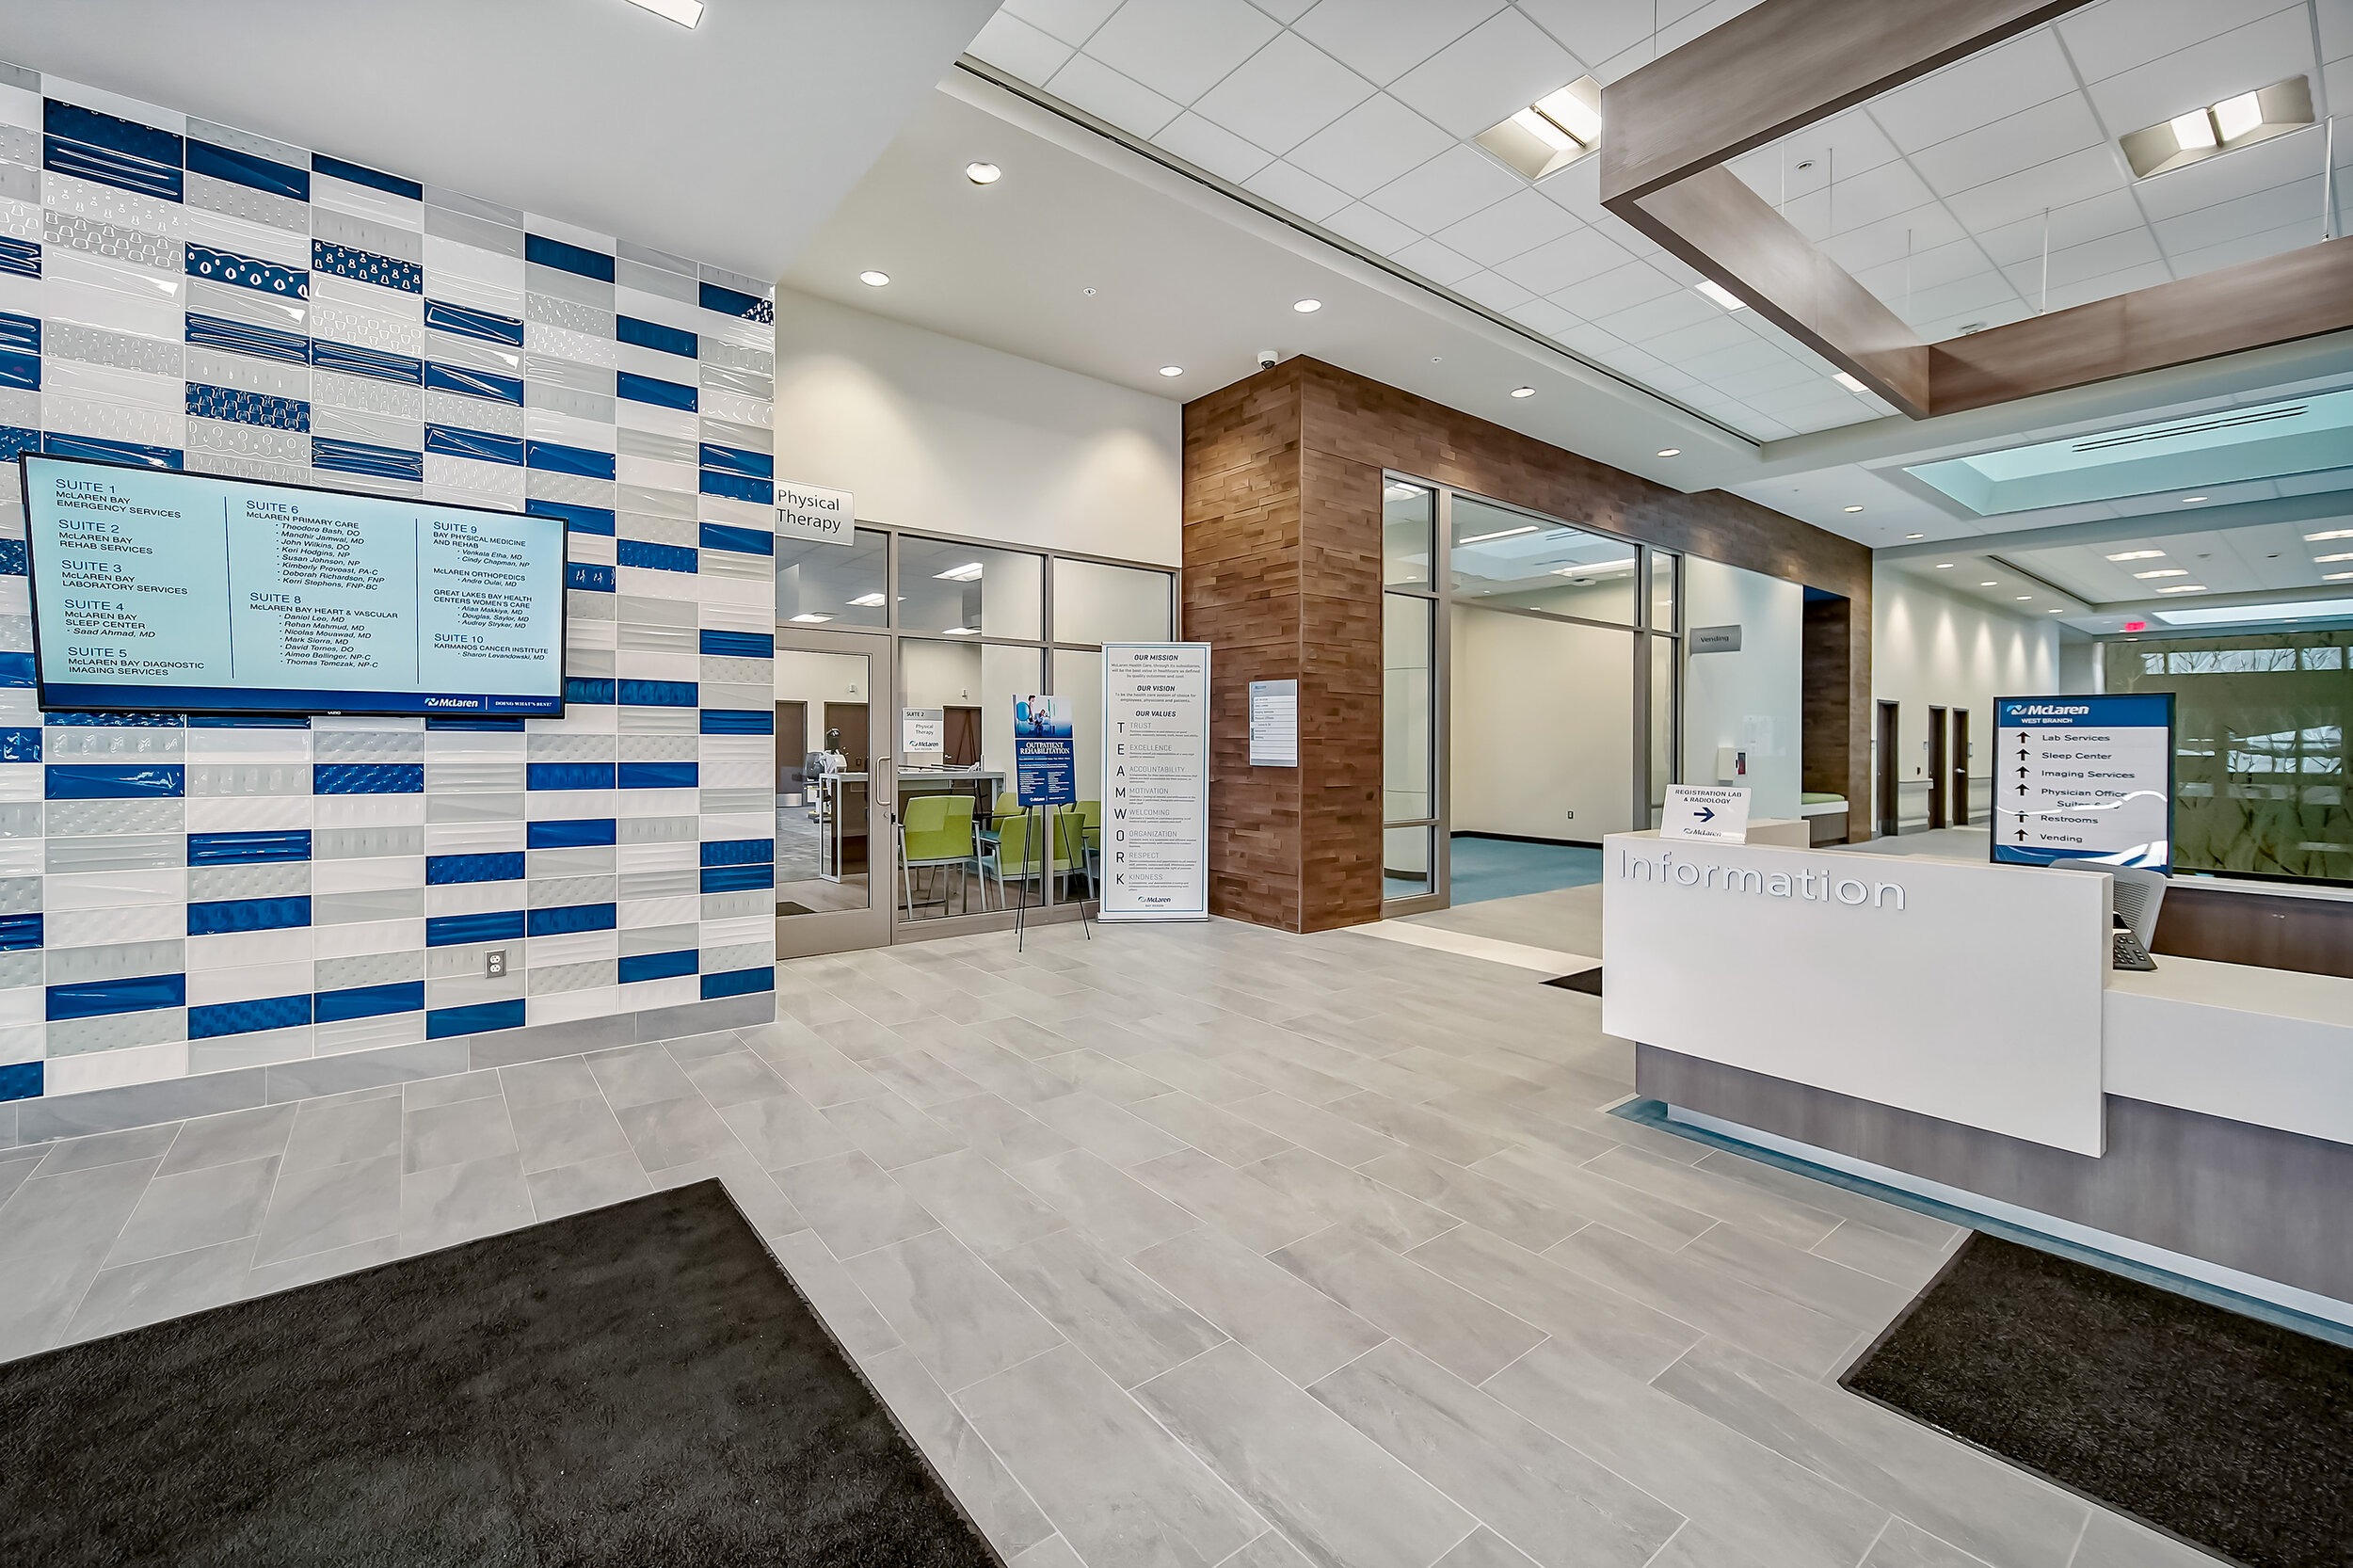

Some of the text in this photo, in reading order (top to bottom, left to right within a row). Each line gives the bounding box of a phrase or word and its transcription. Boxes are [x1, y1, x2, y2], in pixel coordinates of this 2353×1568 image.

[56, 478, 115, 494] SUITE 1
[56, 490, 131, 504] McLAREN BAY
[777, 489, 840, 511] Physical
[56, 499, 181, 519] EMERGENCY SERVICES
[246, 500, 298, 515] SUITE 6
[246, 510, 359, 529] McLAREN PRIMARY CARE
[776, 508, 841, 534] Therapy
[58, 519, 120, 534] SUITE 2
[433, 520, 477, 534] SUITE 9
[58, 531, 133, 544] McLAREN BAY
[280, 530, 314, 539] Mandhir
[315, 534, 348, 544] Jamwal,
[450, 533, 488, 543] PHYSICAL
[489, 537, 526, 547] MEDICINE
[59, 539, 152, 554] REHAB SERVICES
[303, 540, 334, 550] Wilkins,
[452, 540, 479, 549] REHAB
[61, 559, 121, 573] SUITE 3
[281, 553, 308, 562] Susan
[309, 555, 345, 566] Johnson,
[461, 555, 482, 565] Cindy
[483, 557, 518, 568] Chapman,
[61, 570, 136, 583] McLAREN BAY
[282, 568, 317, 578] Deborah
[319, 571, 365, 583] Richardson,
[433, 568, 525, 582] McLAREN ORTHOPEDICS
[62, 580, 188, 595] LABORATORY SERVICES
[433, 588, 460, 597] GREAT
[249, 591, 301, 604] SUITE 8
[433, 596, 471, 604] CENTERS
[472, 599, 508, 607] WOMEN'S
[64, 599, 124, 611] SUITE 4
[249, 603, 293, 612] McLAREN
[314, 607, 344, 616] HEART
[353, 610, 398, 618] VASCULAR
[64, 610, 115, 619] McLAREN
[65, 618, 145, 629] SLEEP CENTER
[312, 622, 349, 631] Mahmud,
[72, 627, 99, 635] Saad
[100, 629, 136, 638] Ahmad,
[284, 628, 314, 636] Nicolas
[434, 632, 484, 644] SUITE 10
[68, 646, 127, 658] SUITE 5
[434, 642, 478, 651] KARMANOS
[68, 658, 118, 666] McLAREN
[142, 660, 204, 669] DIAGNOSTIC
[69, 665, 168, 676] IMAGING SERVICES
[439, 698, 478, 708] McLaren
[2027, 705, 2089, 715] McLaren
[2041, 752, 2072, 760] Sleep
[2041, 770, 2084, 778] Imaging
[2041, 789, 2091, 797] Physician
[2041, 815, 2099, 824] Restrooms
[2041, 833, 2083, 843] Vending
[1620, 849, 1907, 911] Information
